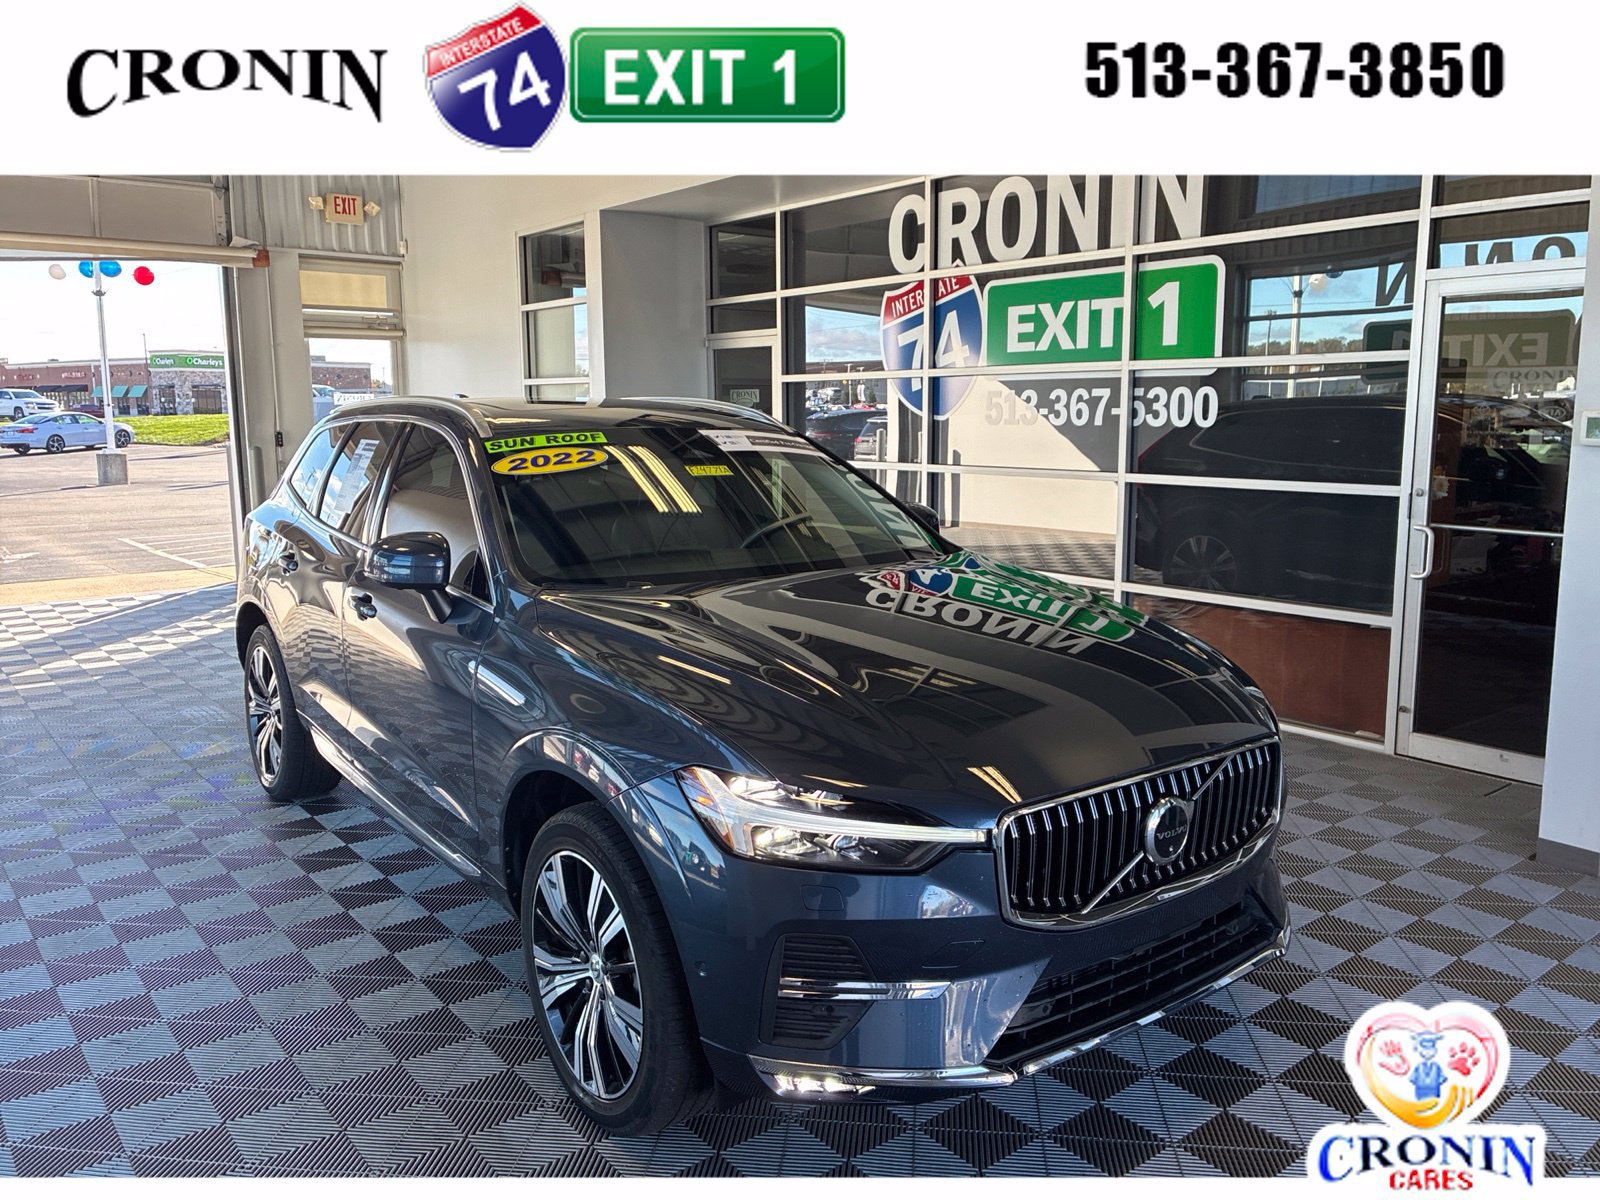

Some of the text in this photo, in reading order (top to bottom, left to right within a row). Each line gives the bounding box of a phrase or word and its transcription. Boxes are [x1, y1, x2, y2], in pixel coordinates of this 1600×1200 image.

[333, 195, 357, 216] EXIT
[888, 175, 1203, 275] CRONIN
[890, 276, 960, 319] INTERATE
[1006, 281, 1180, 353] EXIT 1
[897, 309, 970, 392] 74
[193, 357, 223, 367] Charleys
[731, 390, 758, 401] CRONIN
[984, 385, 1219, 428] 513-367-5300
[490, 432, 601, 450] SUN ROOF
[507, 450, 596, 472] 2022
[1156, 825, 1187, 840] VOLVO
